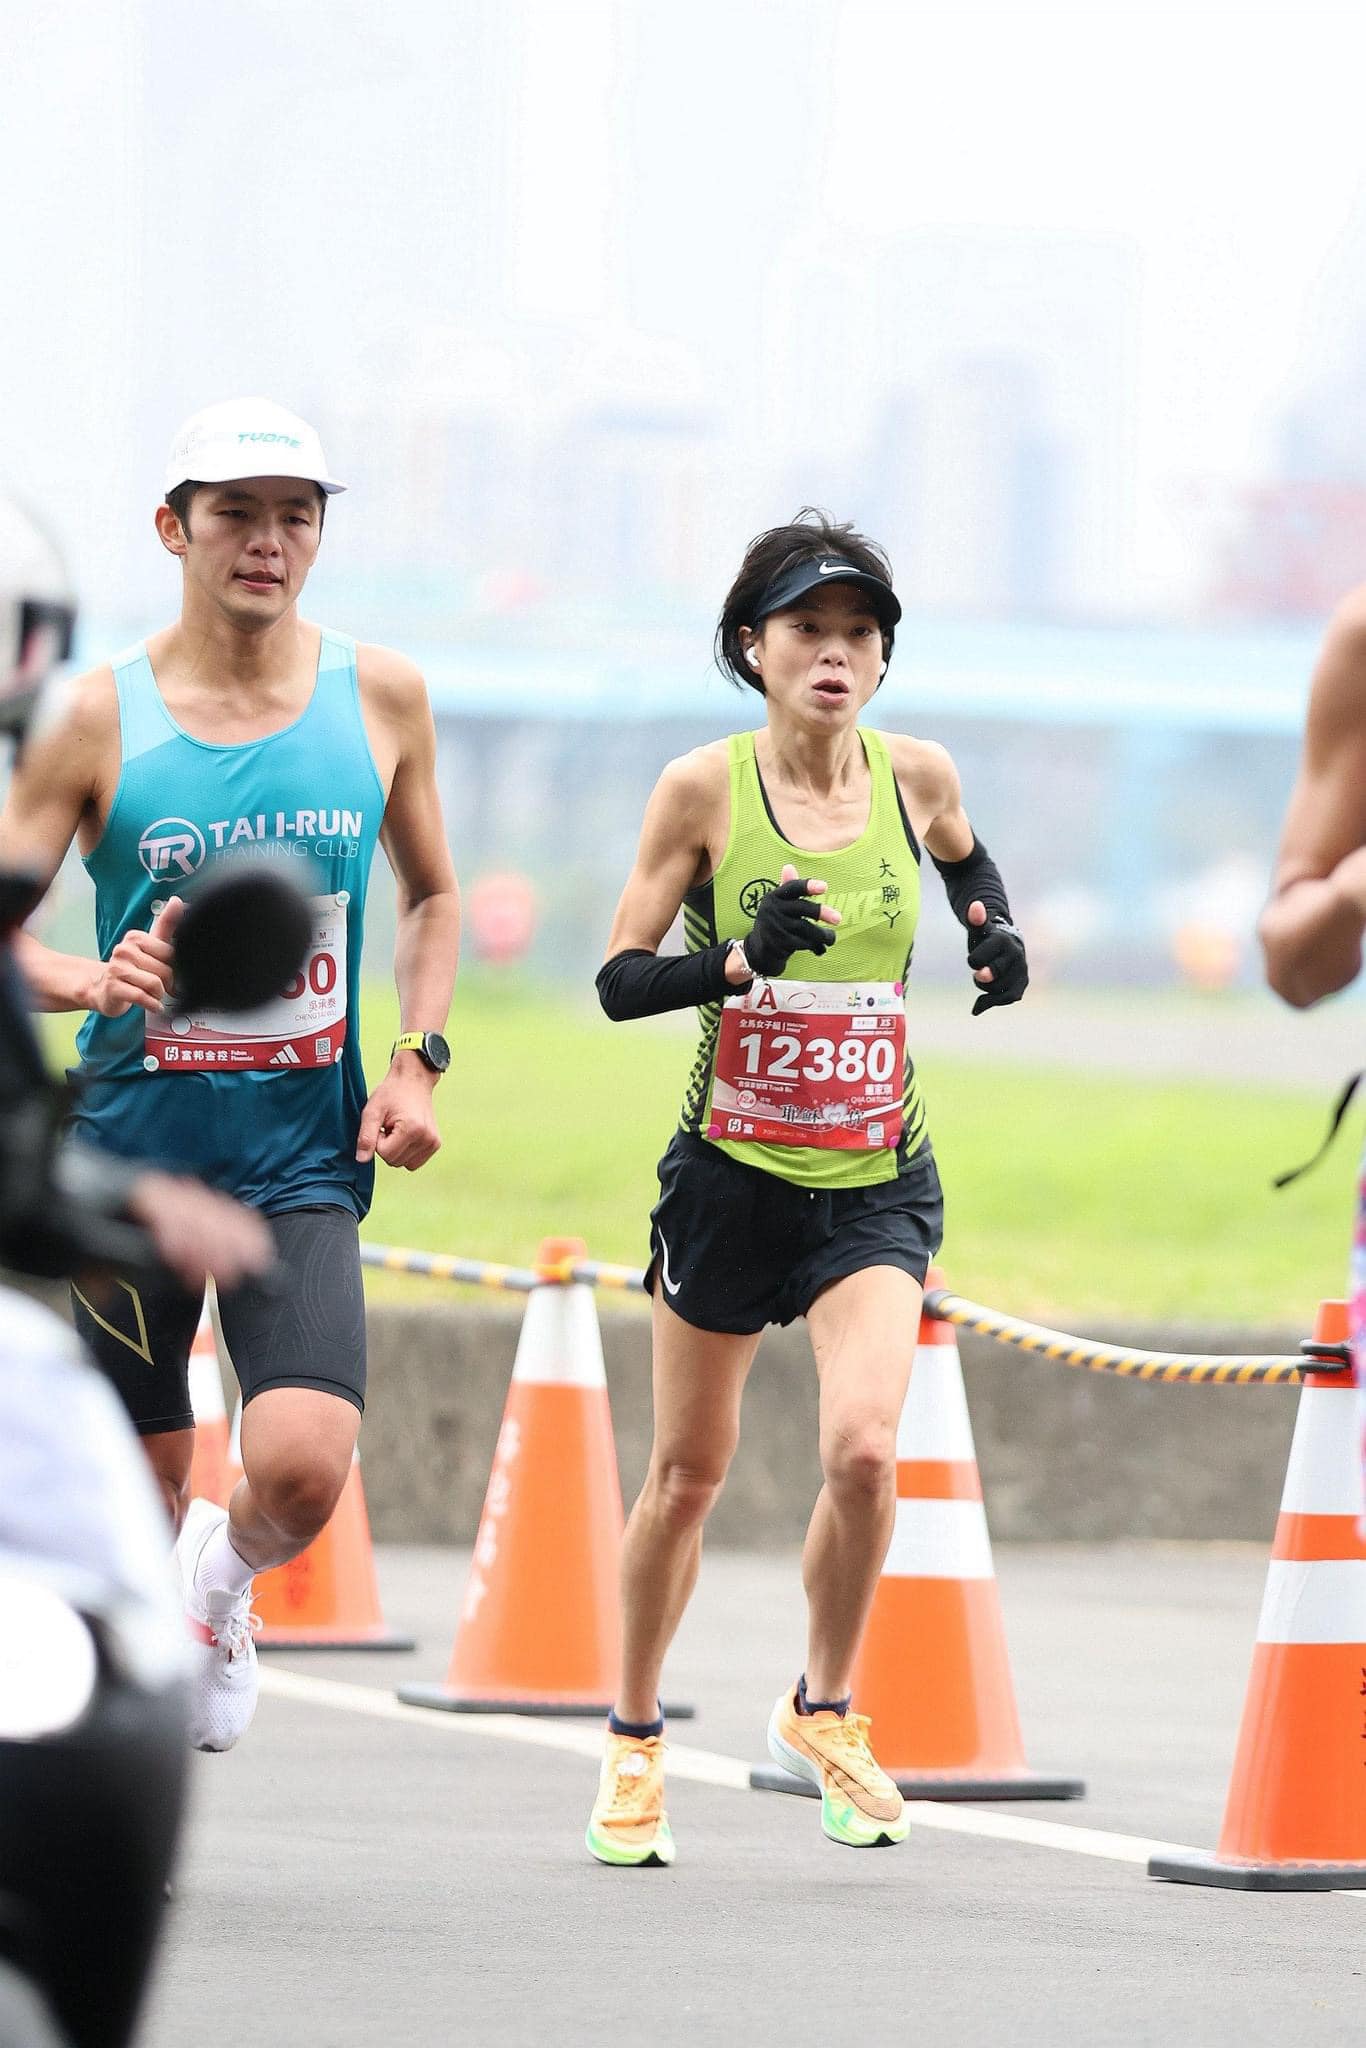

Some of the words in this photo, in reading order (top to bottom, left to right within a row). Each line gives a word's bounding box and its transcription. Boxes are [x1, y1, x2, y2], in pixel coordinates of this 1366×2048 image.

[208, 814, 266, 848] TAI
[276, 809, 363, 838] I-RUN
[314, 840, 360, 858] CLUB
[319, 931, 327, 940] M
[756, 984, 777, 1009] A
[181, 1050, 229, 1063] 富邦金控
[739, 1033, 896, 1083] 12380
